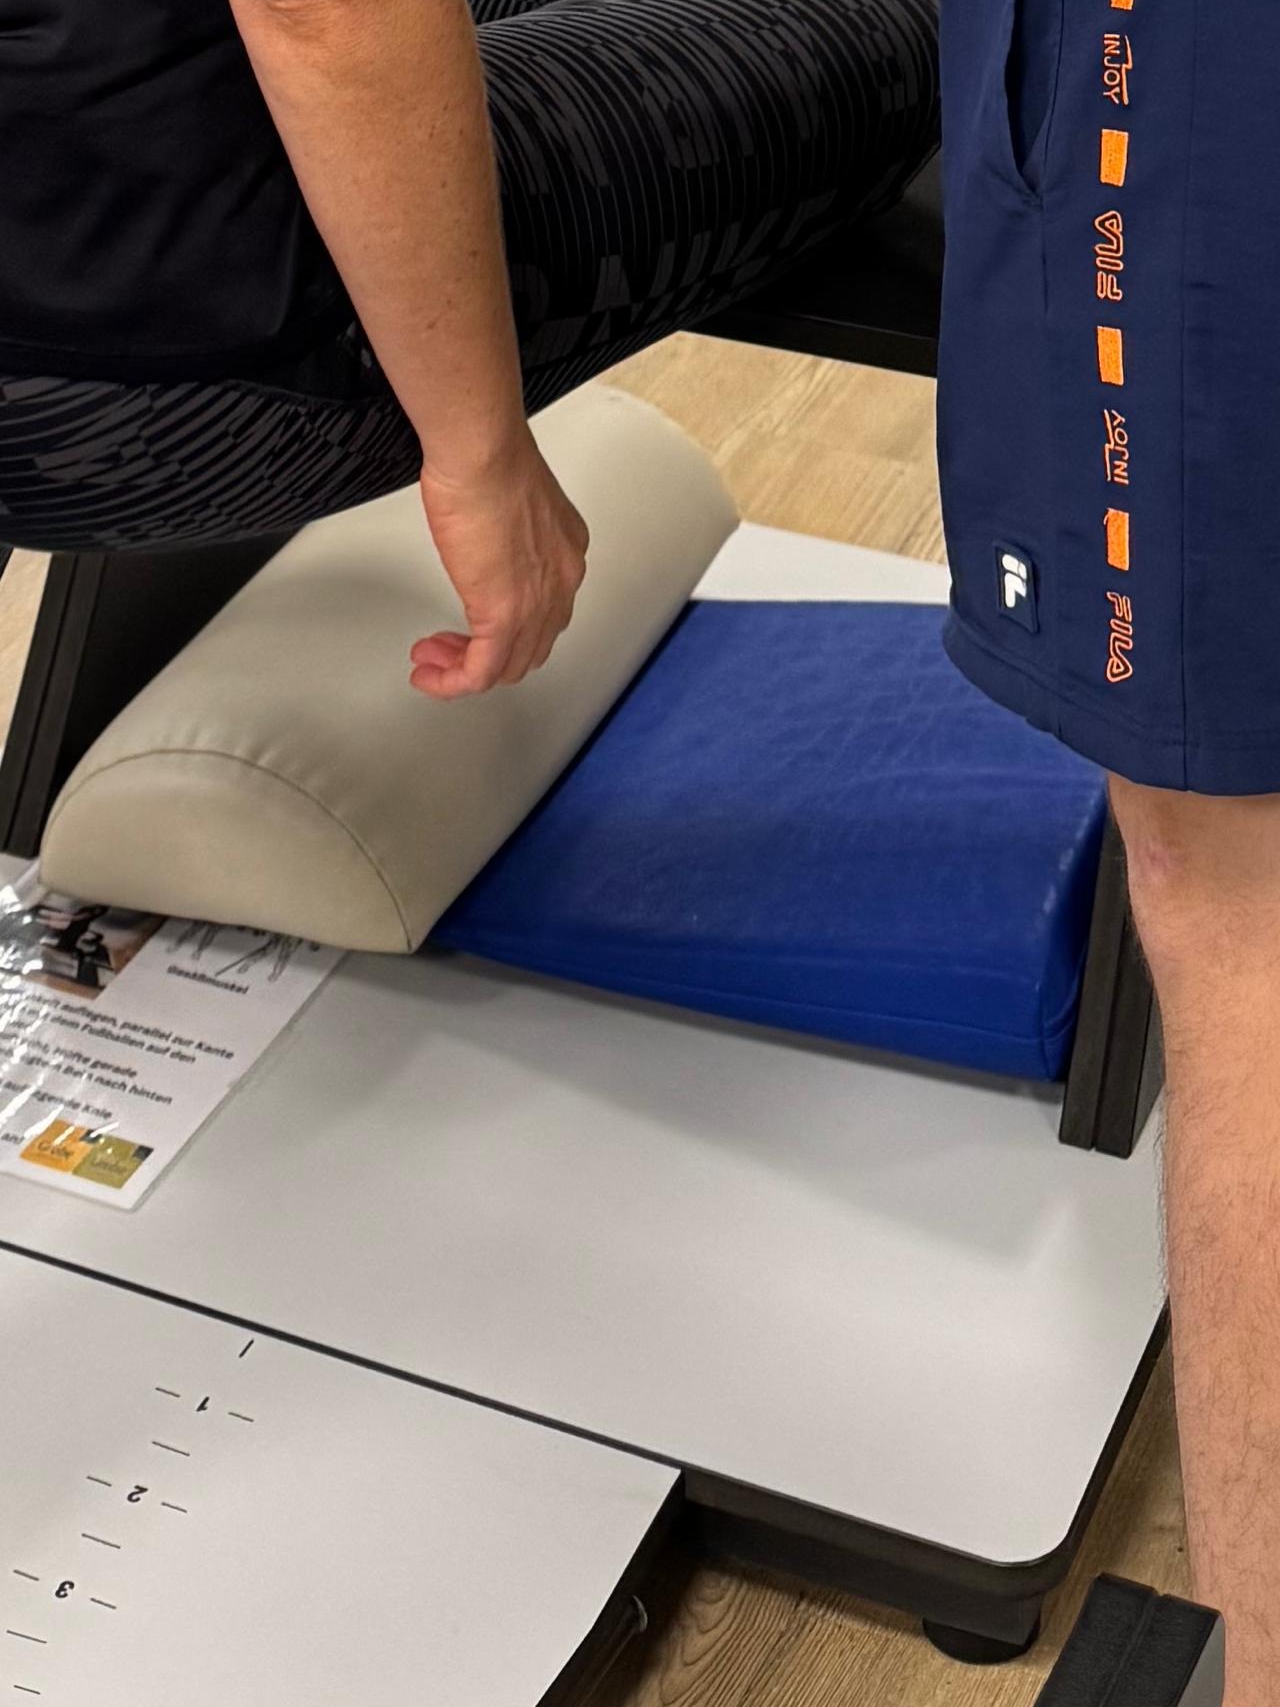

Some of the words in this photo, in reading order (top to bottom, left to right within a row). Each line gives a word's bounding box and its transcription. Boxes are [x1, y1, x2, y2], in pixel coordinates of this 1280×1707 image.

[1094, 210, 1124, 300] FILA
[1106, 590, 1133, 683] FILA
[126, 1485, 149, 1503] 2
[54, 1580, 75, 1599] 3
